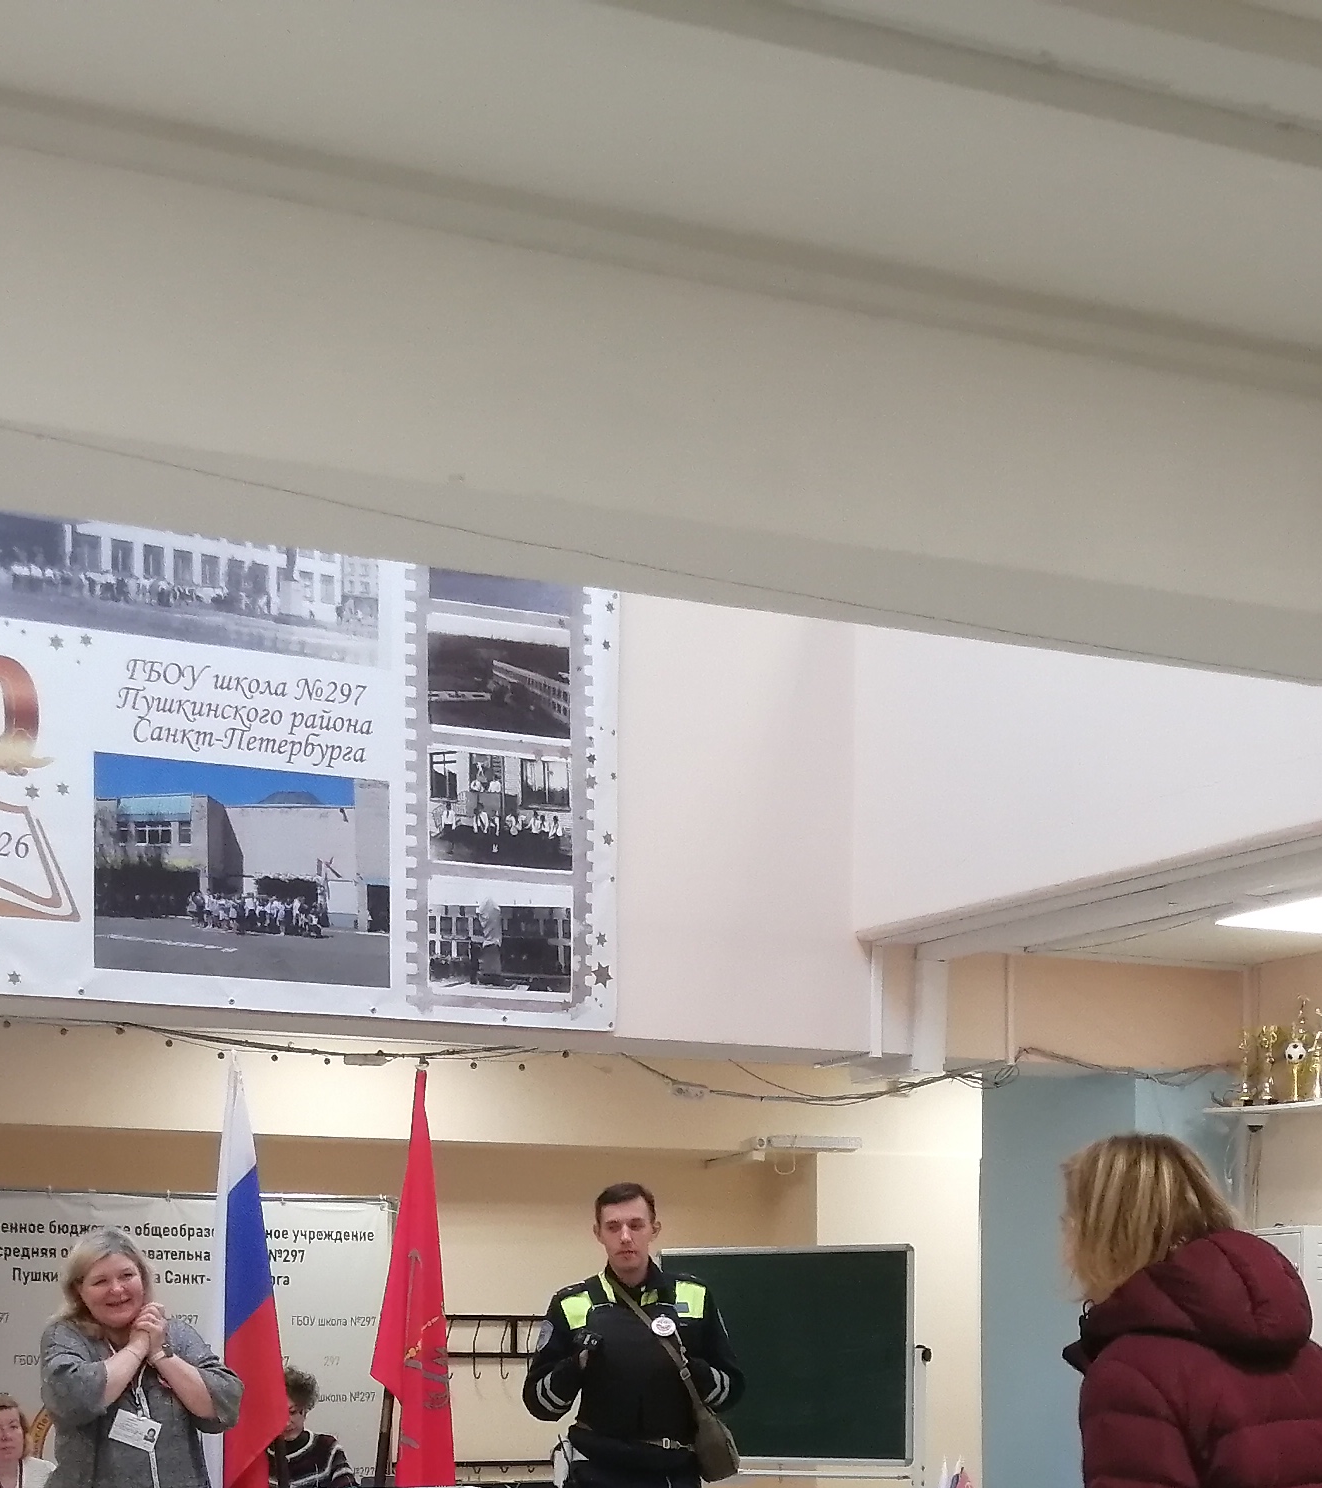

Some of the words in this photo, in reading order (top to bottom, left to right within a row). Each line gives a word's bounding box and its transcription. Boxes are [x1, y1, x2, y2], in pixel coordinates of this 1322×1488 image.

[126, 659, 211, 690] ГБОУ
[213, 673, 287, 699] школа
[294, 678, 367, 706] №297
[116, 686, 283, 729] Пушкинского
[289, 710, 374, 736] района
[133, 716, 367, 768] Санкт-Петербурга
[49, 1220, 130, 1236] бюджее
[292, 1228, 375, 1244] учреждение
[291, 1315, 315, 1326] ГБОУ
[318, 1317, 348, 1327] школа
[350, 1316, 376, 1327] №297
[349, 1392, 376, 1402] №297
